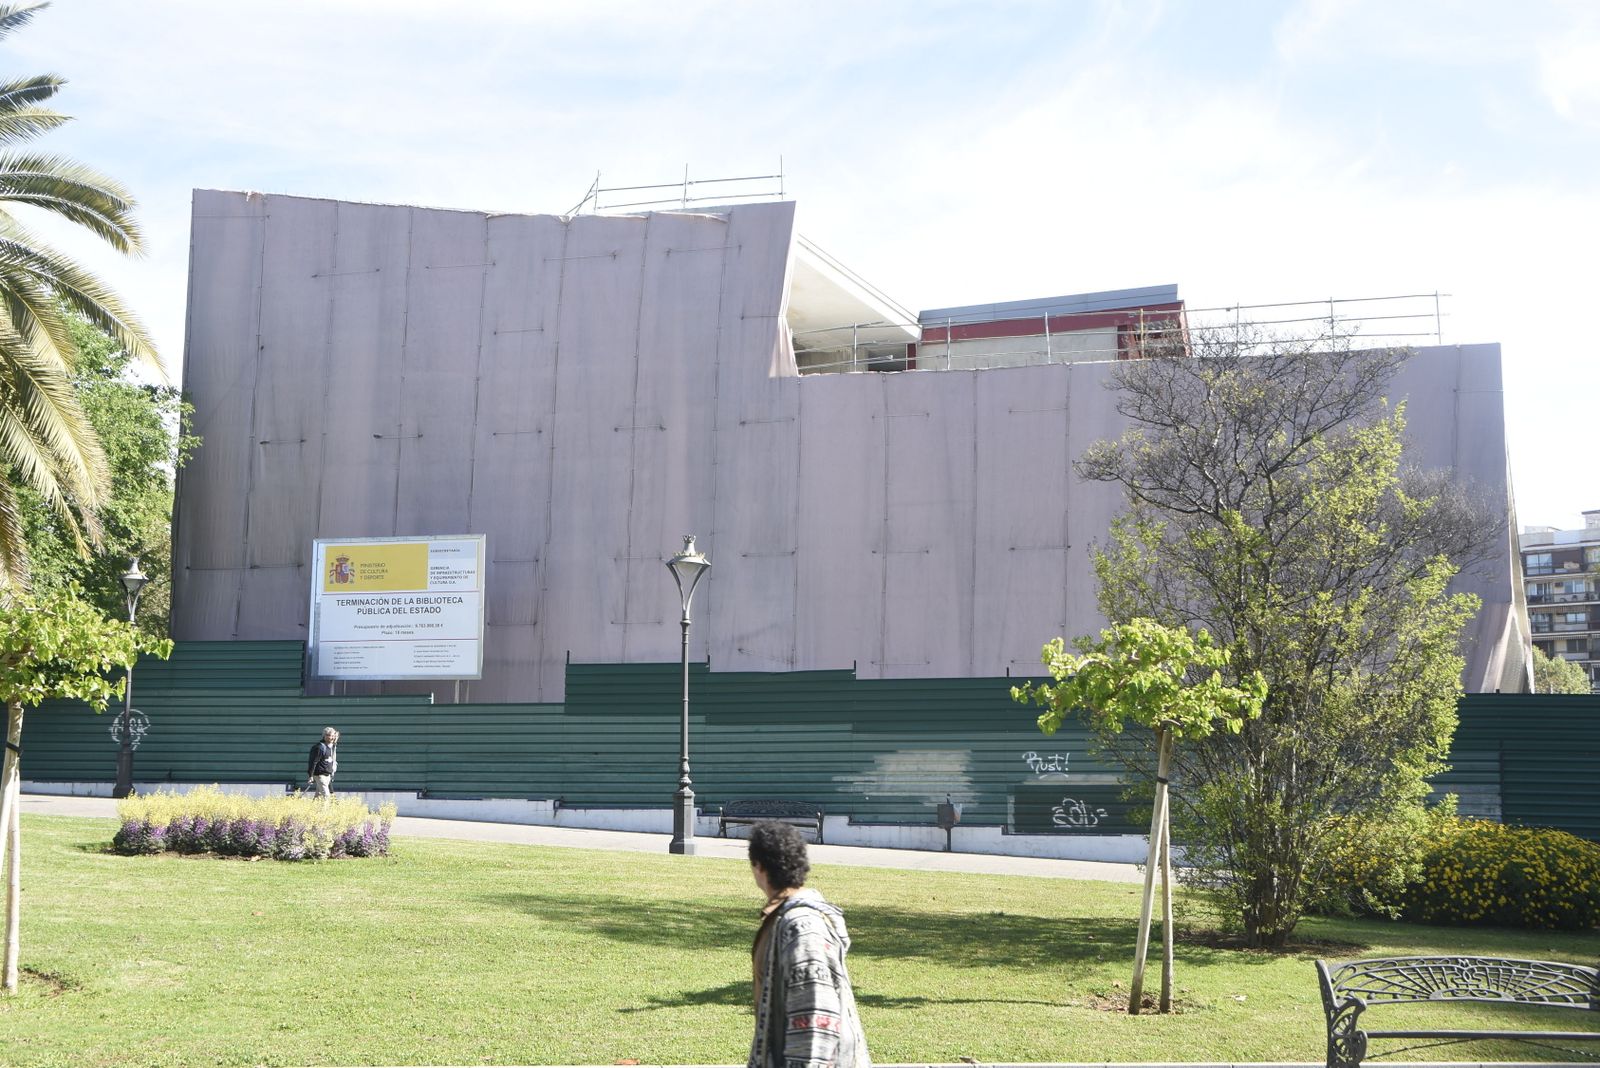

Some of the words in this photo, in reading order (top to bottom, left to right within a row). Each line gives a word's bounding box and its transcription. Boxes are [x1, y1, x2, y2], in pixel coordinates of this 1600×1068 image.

[336, 597, 389, 606] TERMINACIÓN
[416, 596, 463, 604] BIBLIOTECA
[357, 606, 390, 615] PÚBLICA
